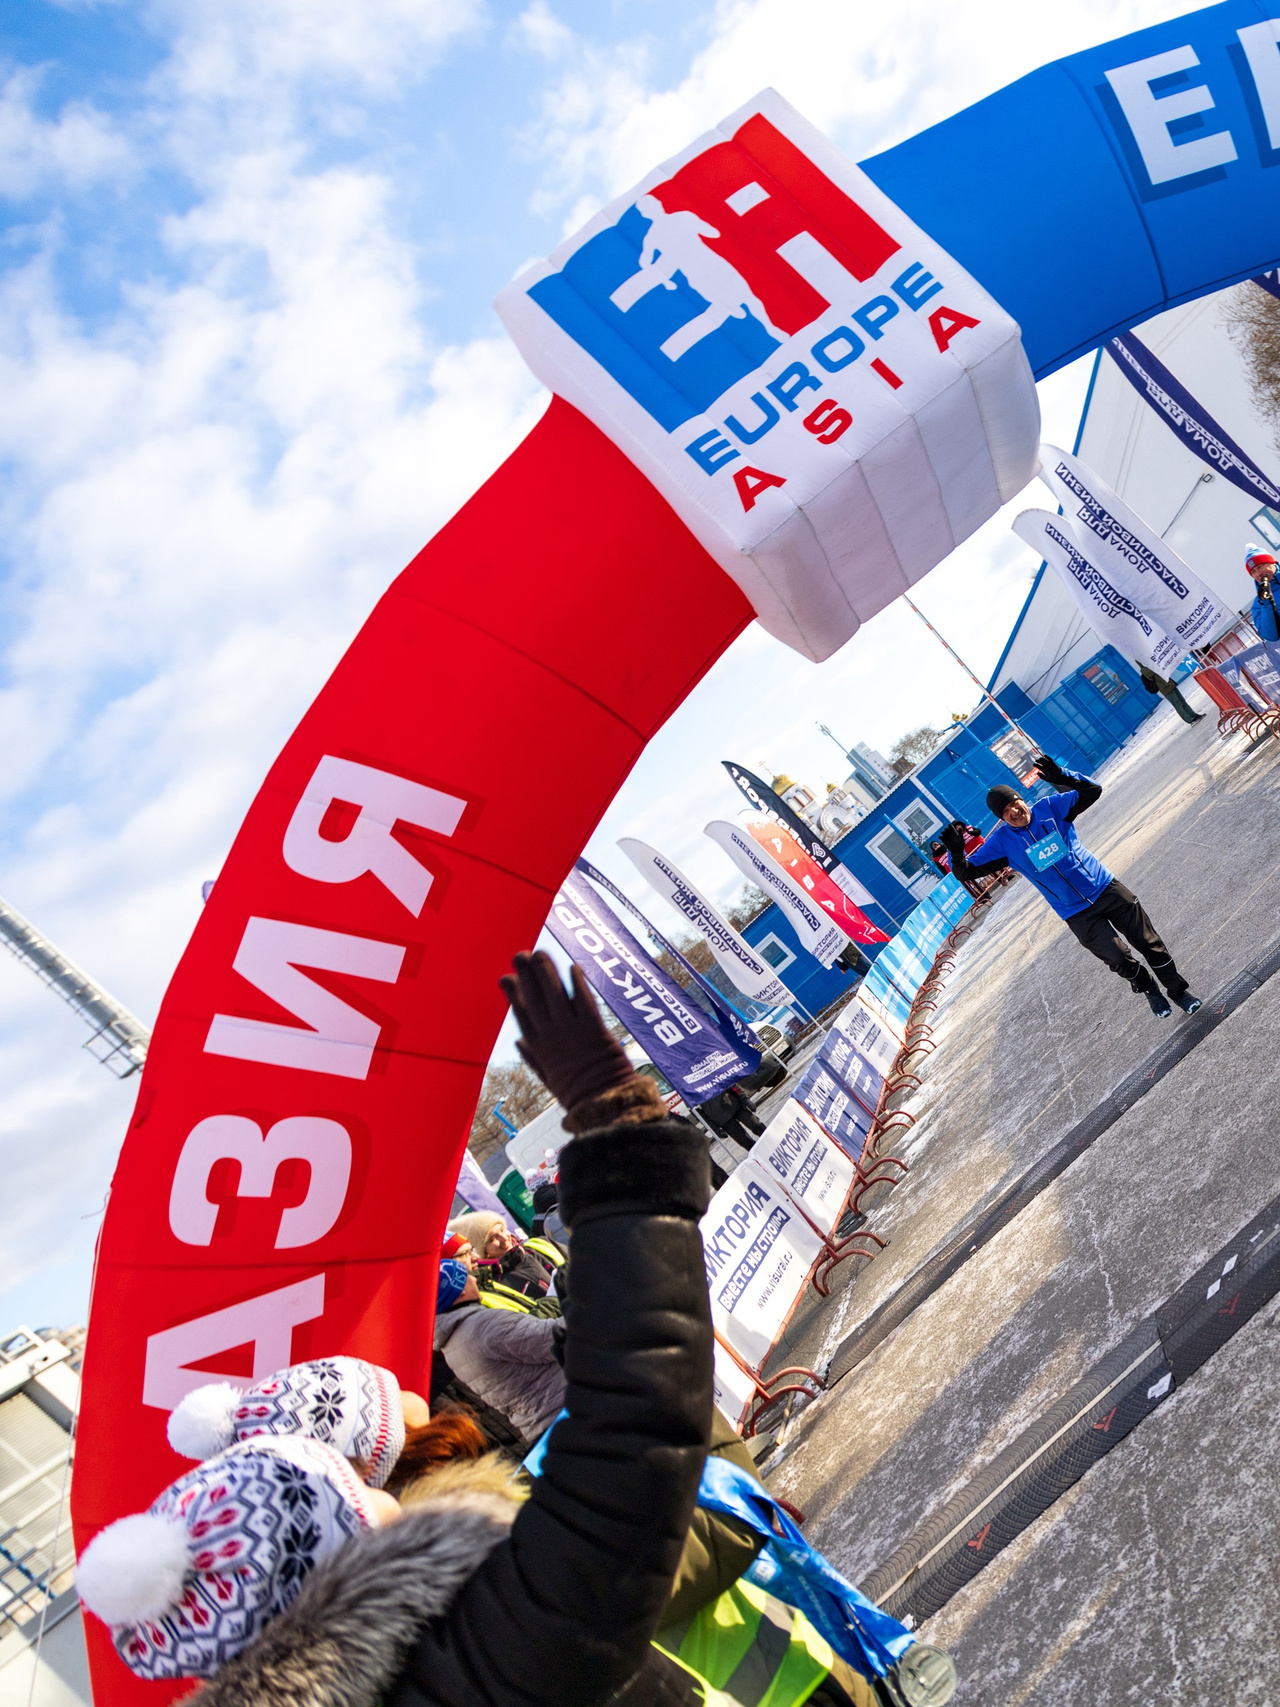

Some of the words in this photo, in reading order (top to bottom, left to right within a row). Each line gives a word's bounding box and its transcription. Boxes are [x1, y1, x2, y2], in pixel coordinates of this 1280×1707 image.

[684, 261, 944, 477] EUROPE
[732, 305, 982, 514] ASIA
[1184, 423, 1234, 471] ДОМА
[1055, 464, 1103, 514] ЖИЗНИ
[1078, 507, 1110, 537] ДЛЯ
[1045, 524, 1086, 565] ЖИЗНИ
[1100, 513, 1189, 597] СЧАСТЛИВОЙ
[1107, 535, 1150, 575] ДОМА
[1066, 560, 1092, 587] ДЛЯ
[1082, 563, 1152, 634] СЧАСТЛИВОЙ
[1088, 586, 1120, 620] ДОМА
[1176, 597, 1210, 634] ВИКТОРИЯ
[1189, 612, 1222, 648] www.visural.ru
[1038, 843, 1059, 860] 428
[654, 857, 695, 900] ЖИЗНИ
[762, 868, 820, 929] СЧАСТЛИВОЙ
[672, 892, 698, 919] ДЛЯ
[692, 900, 762, 975] СЧАСТЛИВОЙ
[695, 917, 729, 954] ДОМА
[551, 899, 684, 1049] ВИКТОР
[142, 754, 468, 1412] АЗИЯ
[695, 1061, 749, 1094] www.visural.ru
[767, 1116, 812, 1178] ВИКТОРИЯ
